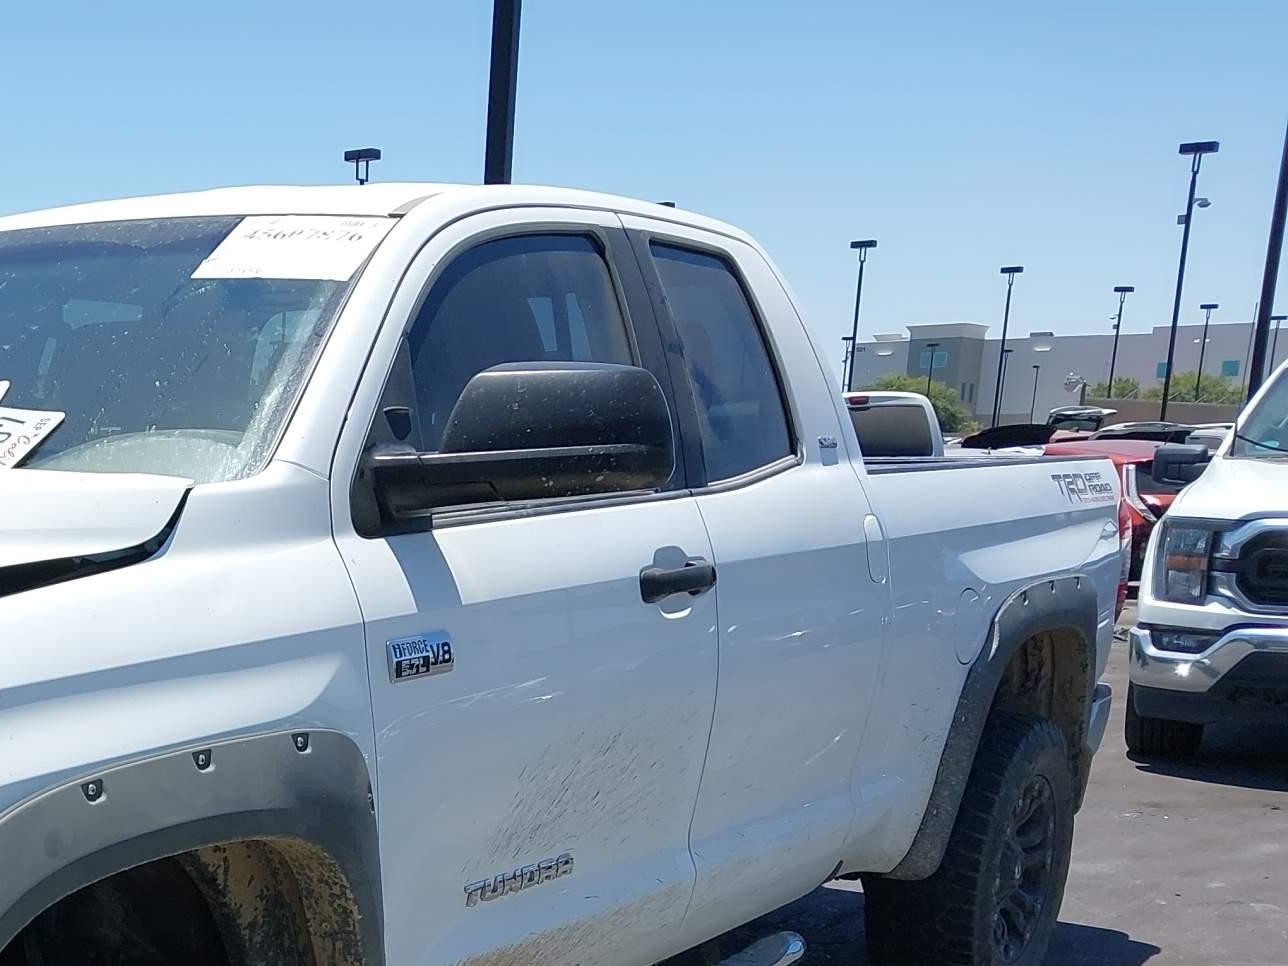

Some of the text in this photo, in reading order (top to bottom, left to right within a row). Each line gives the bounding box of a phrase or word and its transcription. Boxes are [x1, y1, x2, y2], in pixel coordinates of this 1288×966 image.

[1050, 472, 1089, 504] TRD
[1088, 482, 1113, 496] ROAD
[430, 641, 452, 666] V8
[464, 852, 574, 908] TUNDRA
